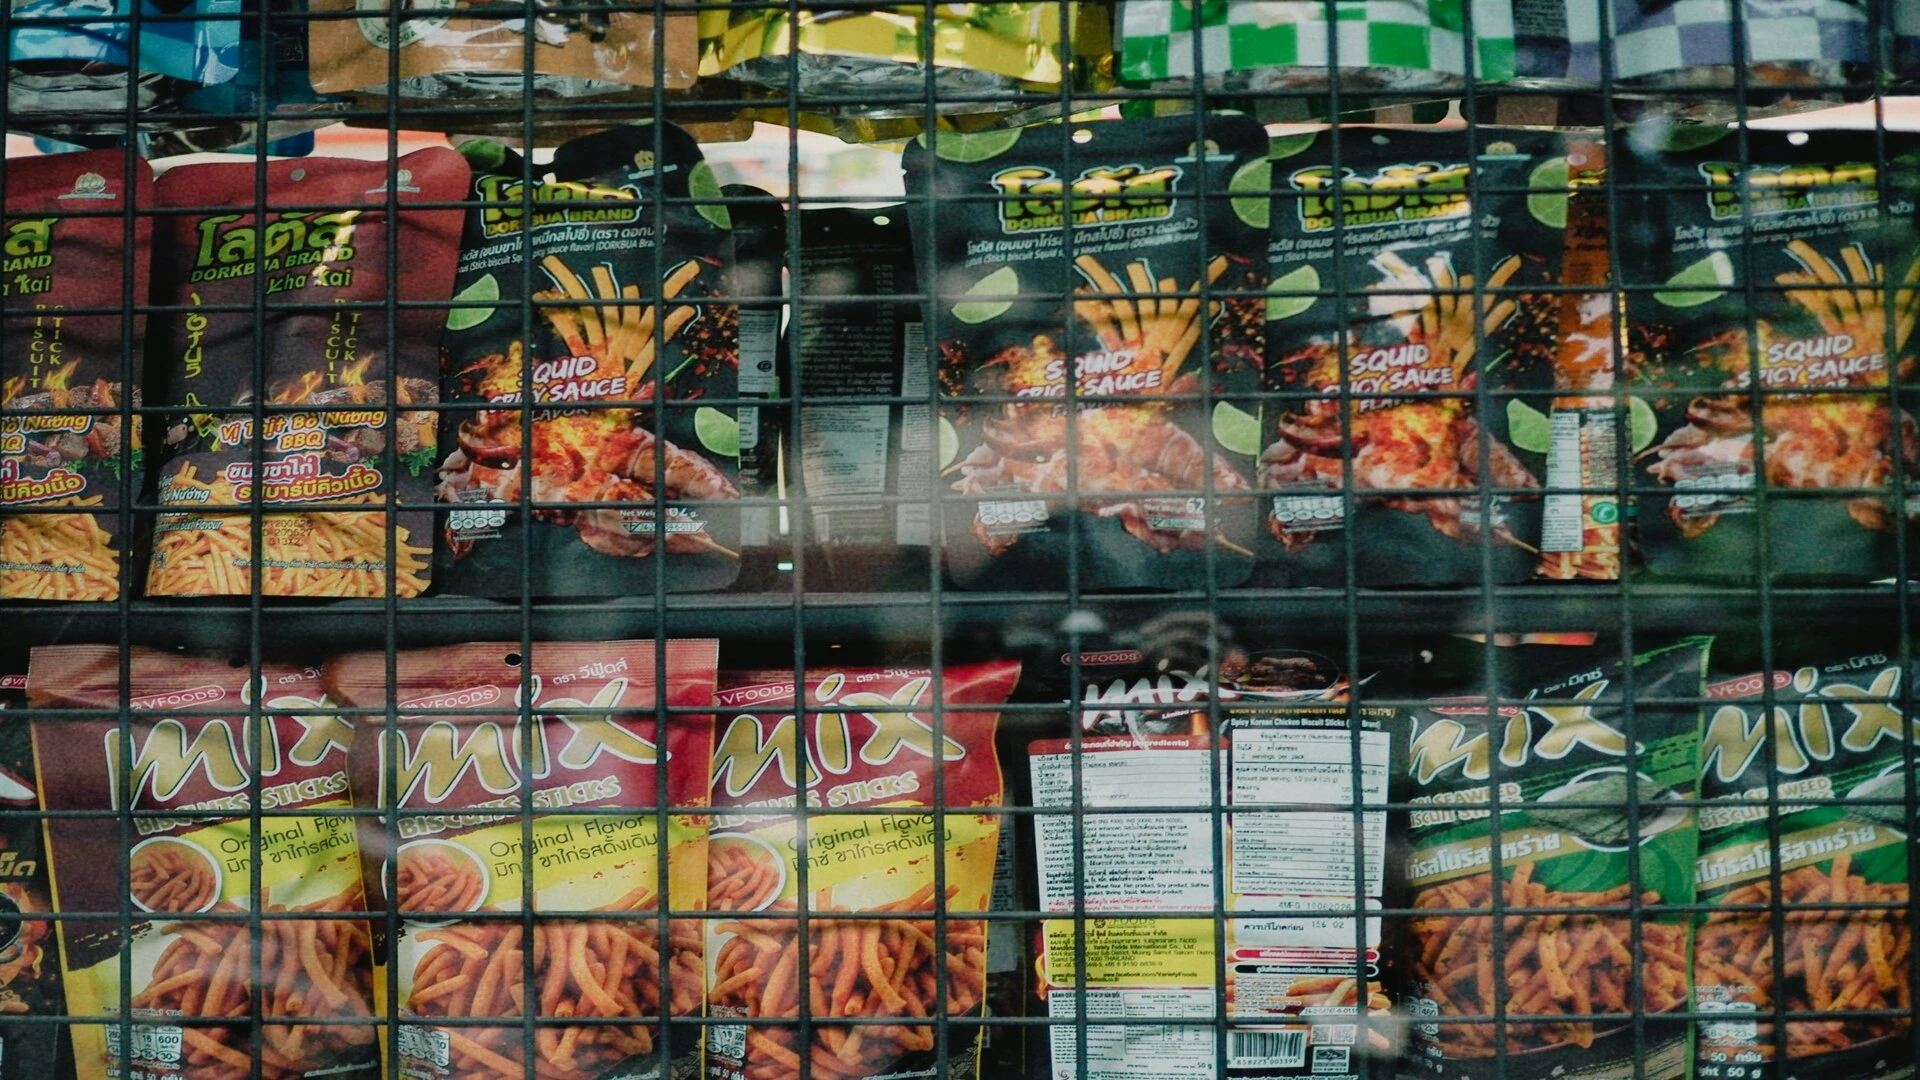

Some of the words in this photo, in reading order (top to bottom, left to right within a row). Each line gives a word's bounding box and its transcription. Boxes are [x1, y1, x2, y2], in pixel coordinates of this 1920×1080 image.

[487, 211, 565, 236] DORBUA
[569, 208, 635, 222] BRAND
[1007, 211, 1098, 230] DORKUA
[1105, 206, 1170, 221] BRAND
[1306, 211, 1396, 229] DOKBUA
[286, 247, 354, 267] BRAND
[49, 304, 64, 365] TICK
[344, 300, 360, 361] TICK
[1351, 344, 1430, 376] SQUID
[1768, 334, 1853, 364] SQUID
[1809, 353, 1885, 381] SAUCE
[490, 388, 545, 412] SPIY
[550, 377, 627, 402] SAUCE
[1015, 384, 1066, 408] SPIC
[1081, 371, 1162, 397] SAUCE
[1324, 377, 1385, 403] SICY
[1385, 367, 1454, 392] SAUCE
[531, 408, 589, 422] LAVOR
[281, 431, 324, 449] BBQ
[1186, 498, 1205, 513] 62
[1080, 651, 1138, 663] VFOODS
[278, 673, 303, 685] ตรา
[553, 674, 576, 686] ตรา
[857, 675, 880, 685] ตรา
[1711, 672, 1786, 699] VFOOS
[143, 689, 219, 710] VFOODS
[418, 689, 494, 709] VFOODS
[722, 683, 796, 705] VFOODS
[1230, 718, 1249, 728] Spicy
[1250, 718, 1273, 727] Korean
[1274, 718, 1301, 727] Chicken
[1301, 718, 1324, 727] Biscuit
[1325, 718, 1346, 727] Sticks
[378, 674, 672, 822] mix
[261, 771, 348, 810] STICKS
[531, 775, 623, 808] STICKS
[827, 771, 920, 806] STICKS
[1409, 808, 1456, 828] ISCUIT
[220, 820, 305, 856] Original
[489, 824, 575, 858] Original
[585, 814, 646, 837] Flavor
[787, 821, 870, 852] Original
[881, 813, 937, 835] Flavo
[158, 1035, 179, 1044] 600
[1711, 1052, 1728, 1062] 50
[1727, 1066, 1746, 1078] 50
[1751, 1069, 1763, 1080] g
